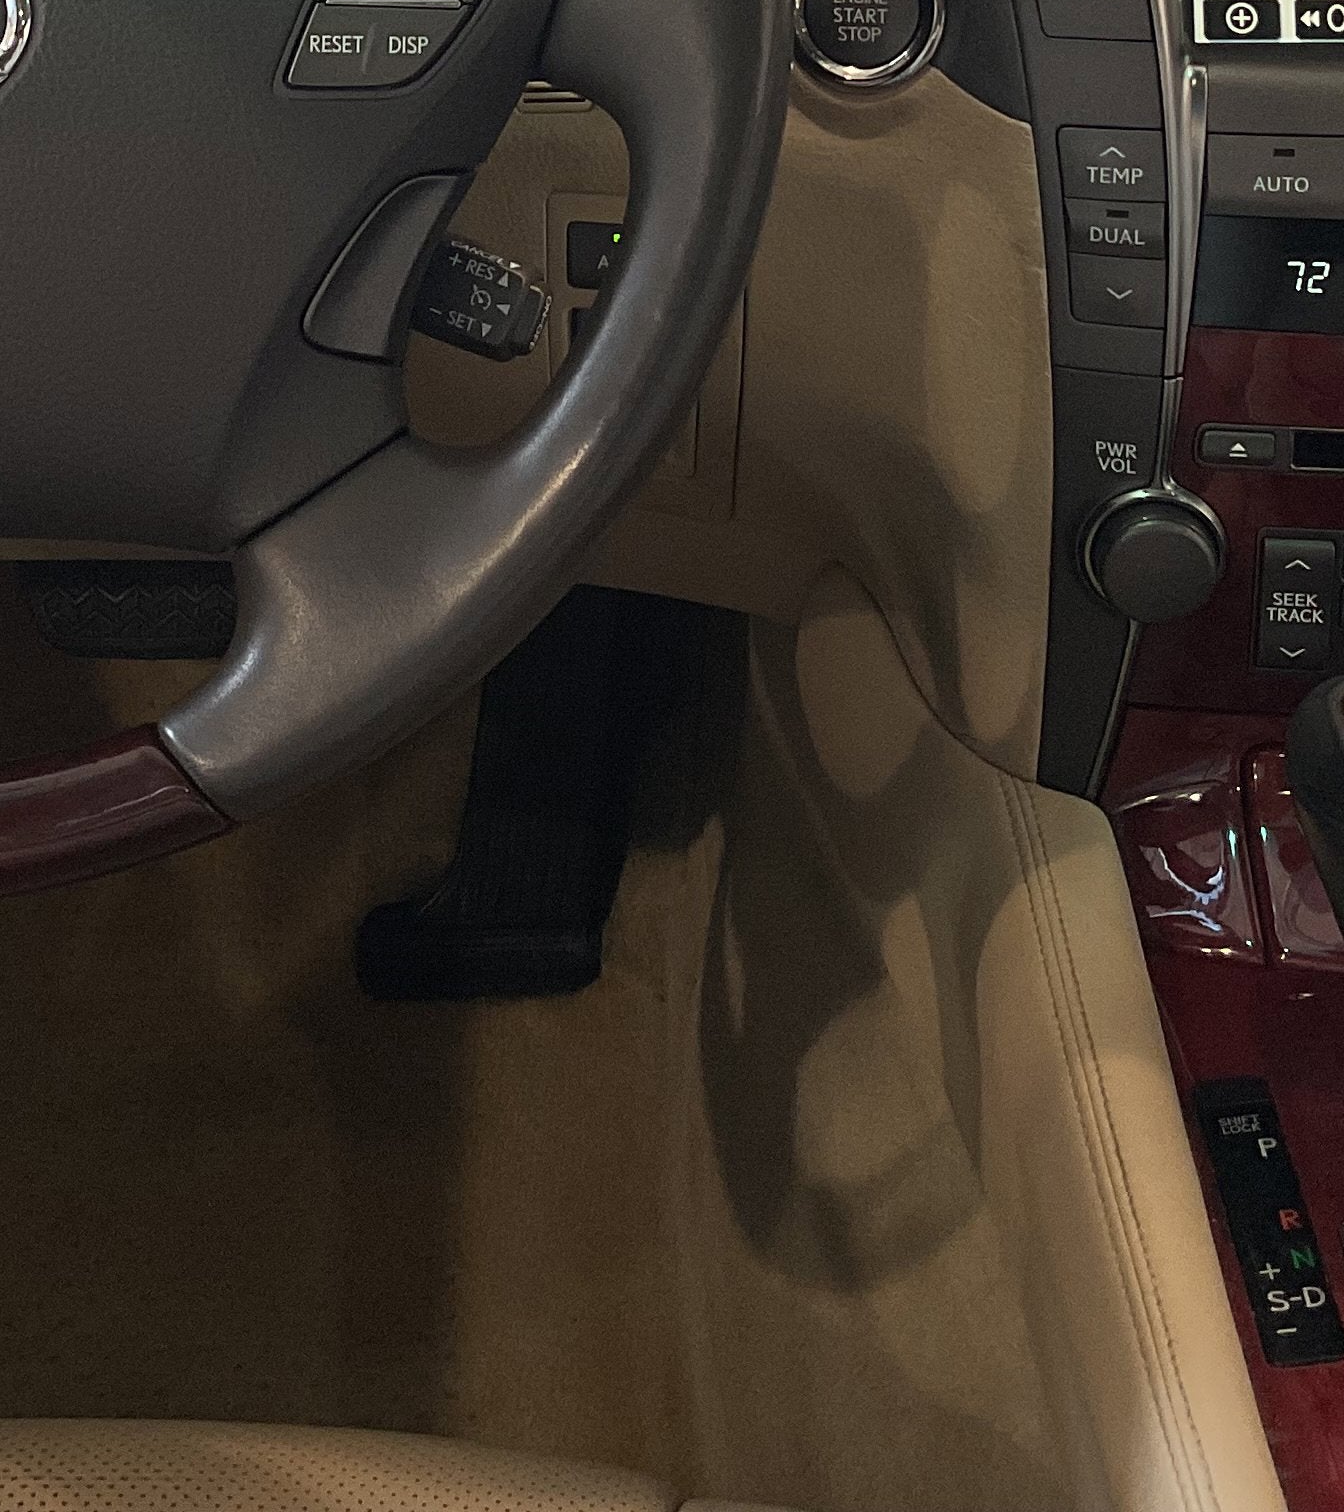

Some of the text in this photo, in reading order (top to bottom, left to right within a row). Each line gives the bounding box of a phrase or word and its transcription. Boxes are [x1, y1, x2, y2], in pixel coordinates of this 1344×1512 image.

[833, 7, 889, 24] START
[837, 26, 883, 42] STOP
[309, 34, 429, 55] RESET DISP
[1085, 165, 1144, 186] TEMP
[1253, 175, 1310, 194] AUTO
[1089, 226, 1146, 246] DUAL
[464, 258, 496, 281] RES
[1287, 260, 1331, 295] 72
[445, 309, 477, 333] SET
[1094, 440, 1137, 460] PWR
[1097, 457, 1137, 475] VOL
[1272, 592, 1318, 608] SEEK
[1266, 606, 1324, 625] TRACK
[1217, 1113, 1259, 1127] SHIFT
[1221, 1122, 1262, 1136] LOCK
[1257, 1137, 1277, 1158] P
[1279, 1208, 1303, 1231] R
[1290, 1247, 1316, 1270] N
